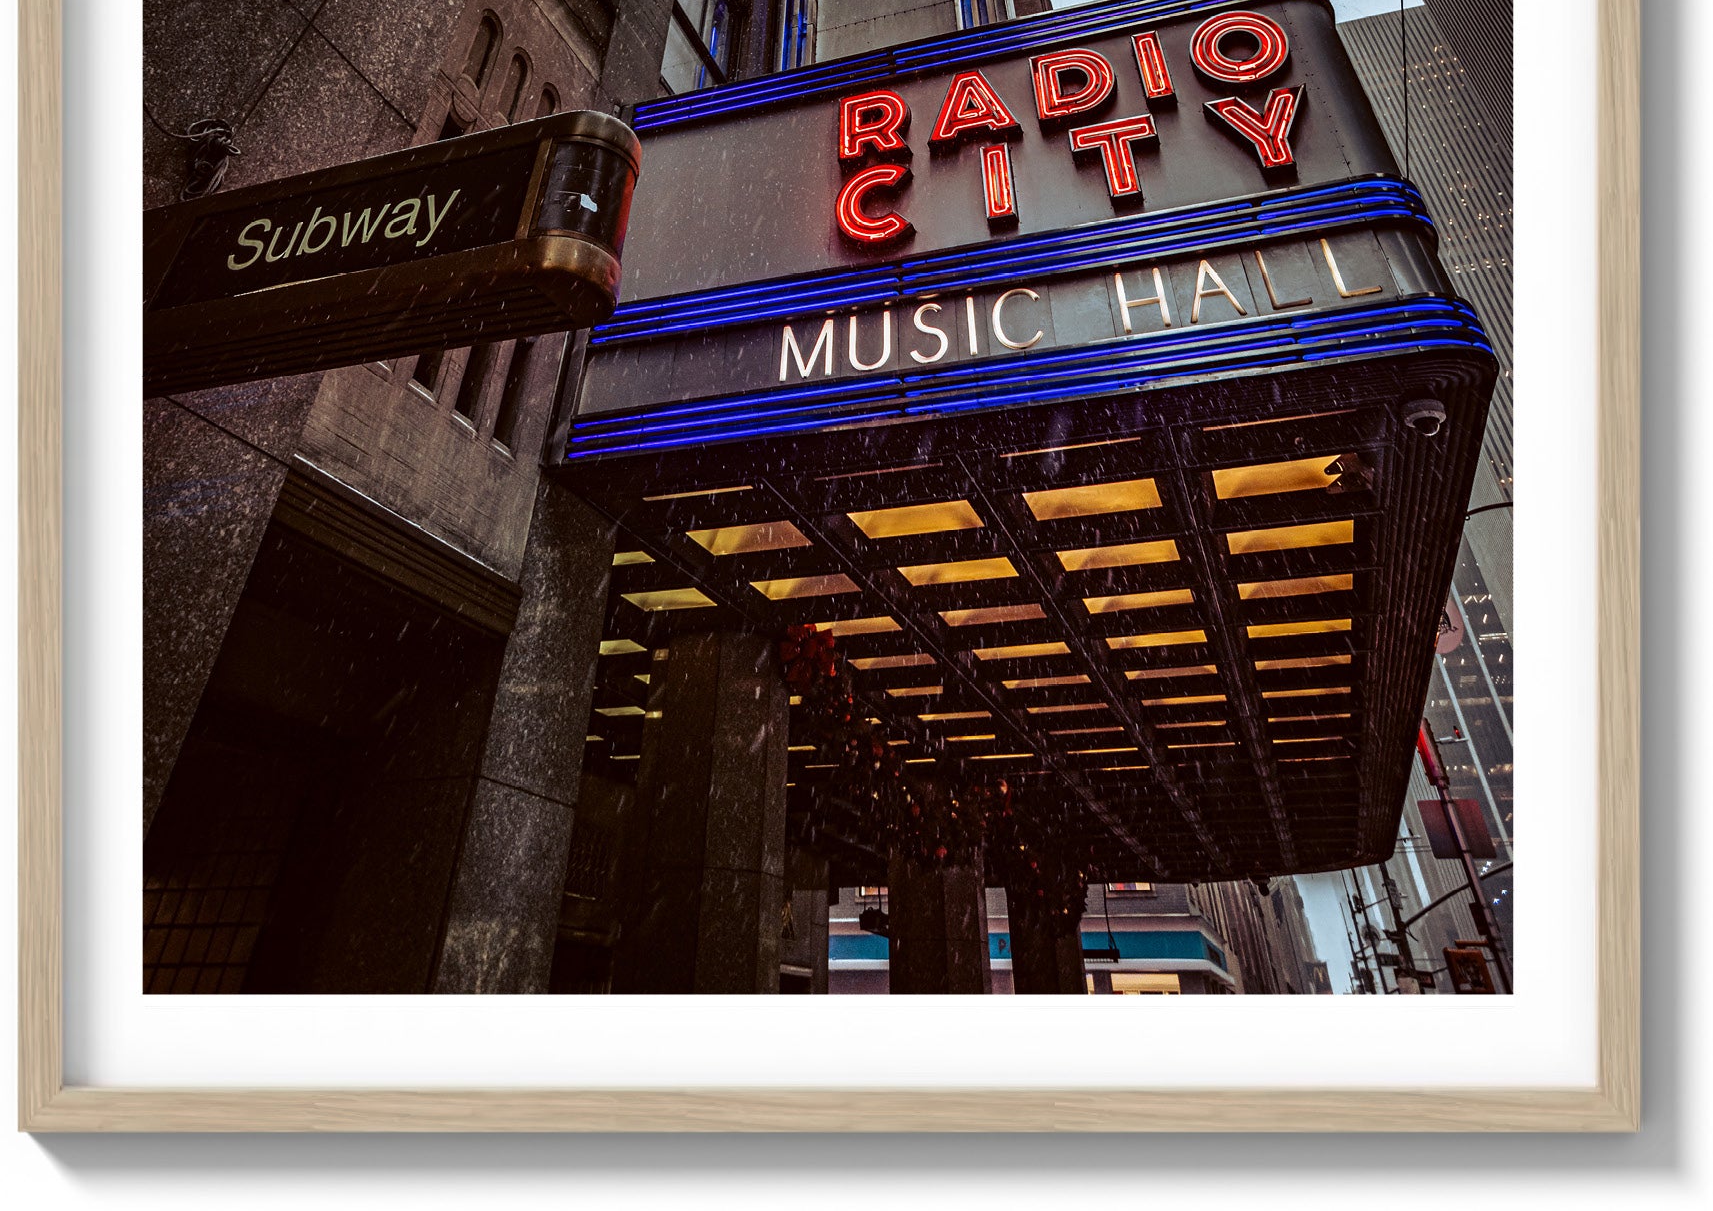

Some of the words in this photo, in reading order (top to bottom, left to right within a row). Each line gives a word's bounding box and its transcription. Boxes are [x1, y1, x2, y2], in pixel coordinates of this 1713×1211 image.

[838, 10, 1290, 161] RADIO
[226, 188, 461, 271] Subway
[835, 84, 1306, 244] CITY
[779, 288, 1044, 382] MUSIC
[1114, 238, 1383, 335] HALL
